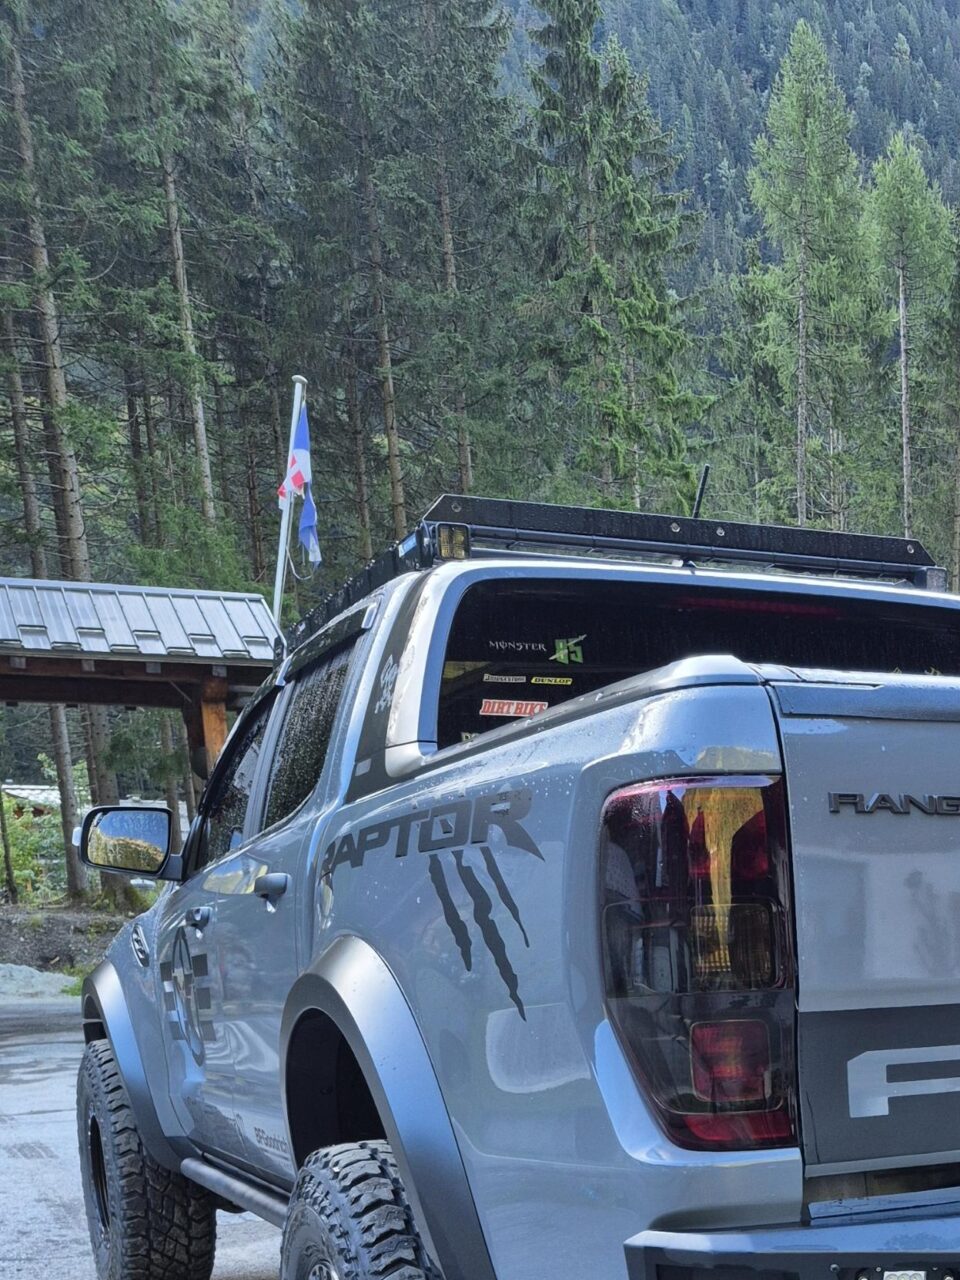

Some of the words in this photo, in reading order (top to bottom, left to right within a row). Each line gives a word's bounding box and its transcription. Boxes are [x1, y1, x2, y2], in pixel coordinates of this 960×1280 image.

[489, 640, 547, 652] MONSTER
[534, 677, 571, 685] DUNLOP
[482, 700, 513, 714] DIRT
[321, 789, 545, 876] RAPTOR
